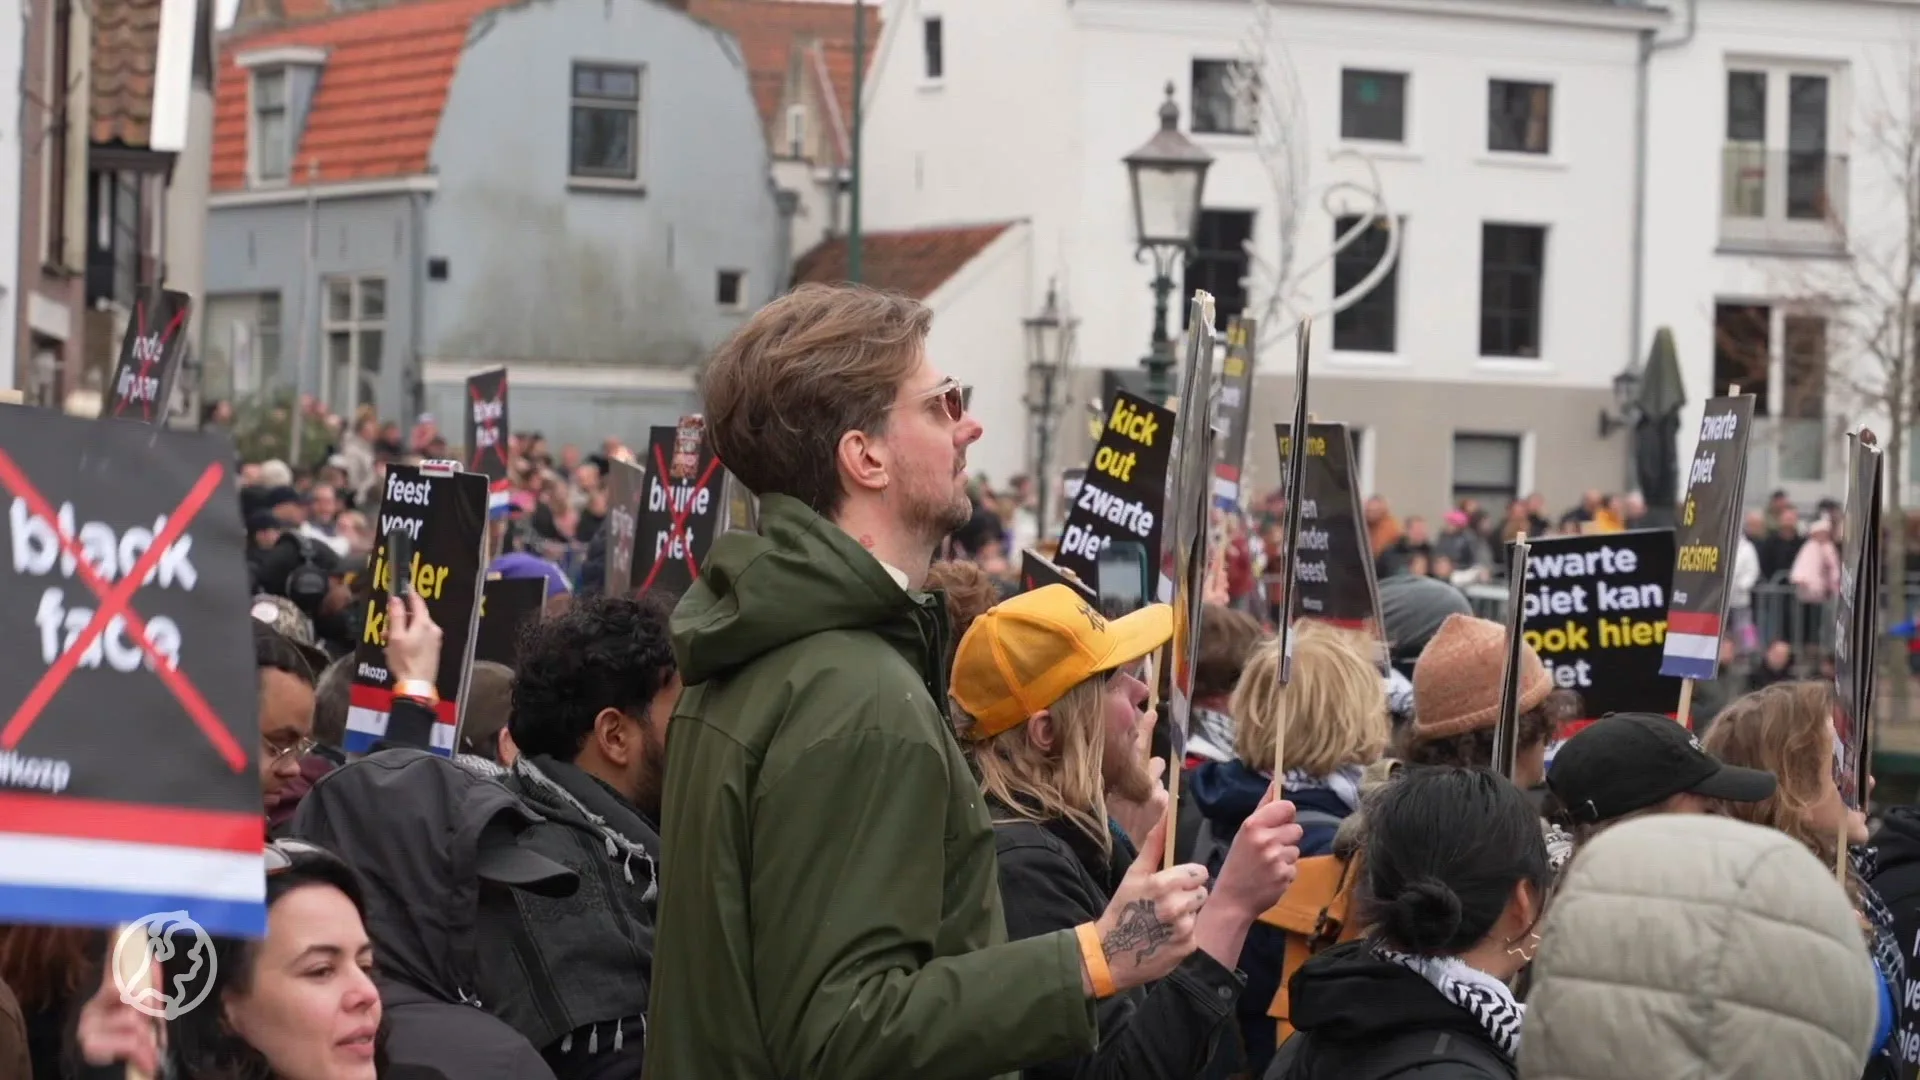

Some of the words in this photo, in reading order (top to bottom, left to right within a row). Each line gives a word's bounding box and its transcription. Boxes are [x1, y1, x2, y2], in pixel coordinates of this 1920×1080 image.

[1109, 398, 1159, 447] kick
[1701, 409, 1738, 442] zwarte
[1095, 446, 1136, 482] out
[1689, 450, 1716, 490] piet
[387, 472, 431, 507] feest
[649, 475, 709, 516] bruine
[1077, 484, 1154, 538] zwarte
[1683, 493, 1696, 527] is
[9, 495, 198, 592] black
[655, 523, 694, 561] piet
[1676, 538, 1719, 573] racisme
[1597, 579, 1665, 612] kan
[35, 586, 182, 674] face
[1598, 616, 1669, 649] hier
[358, 661, 388, 684] #kozp
[1543, 657, 1593, 688] iet
